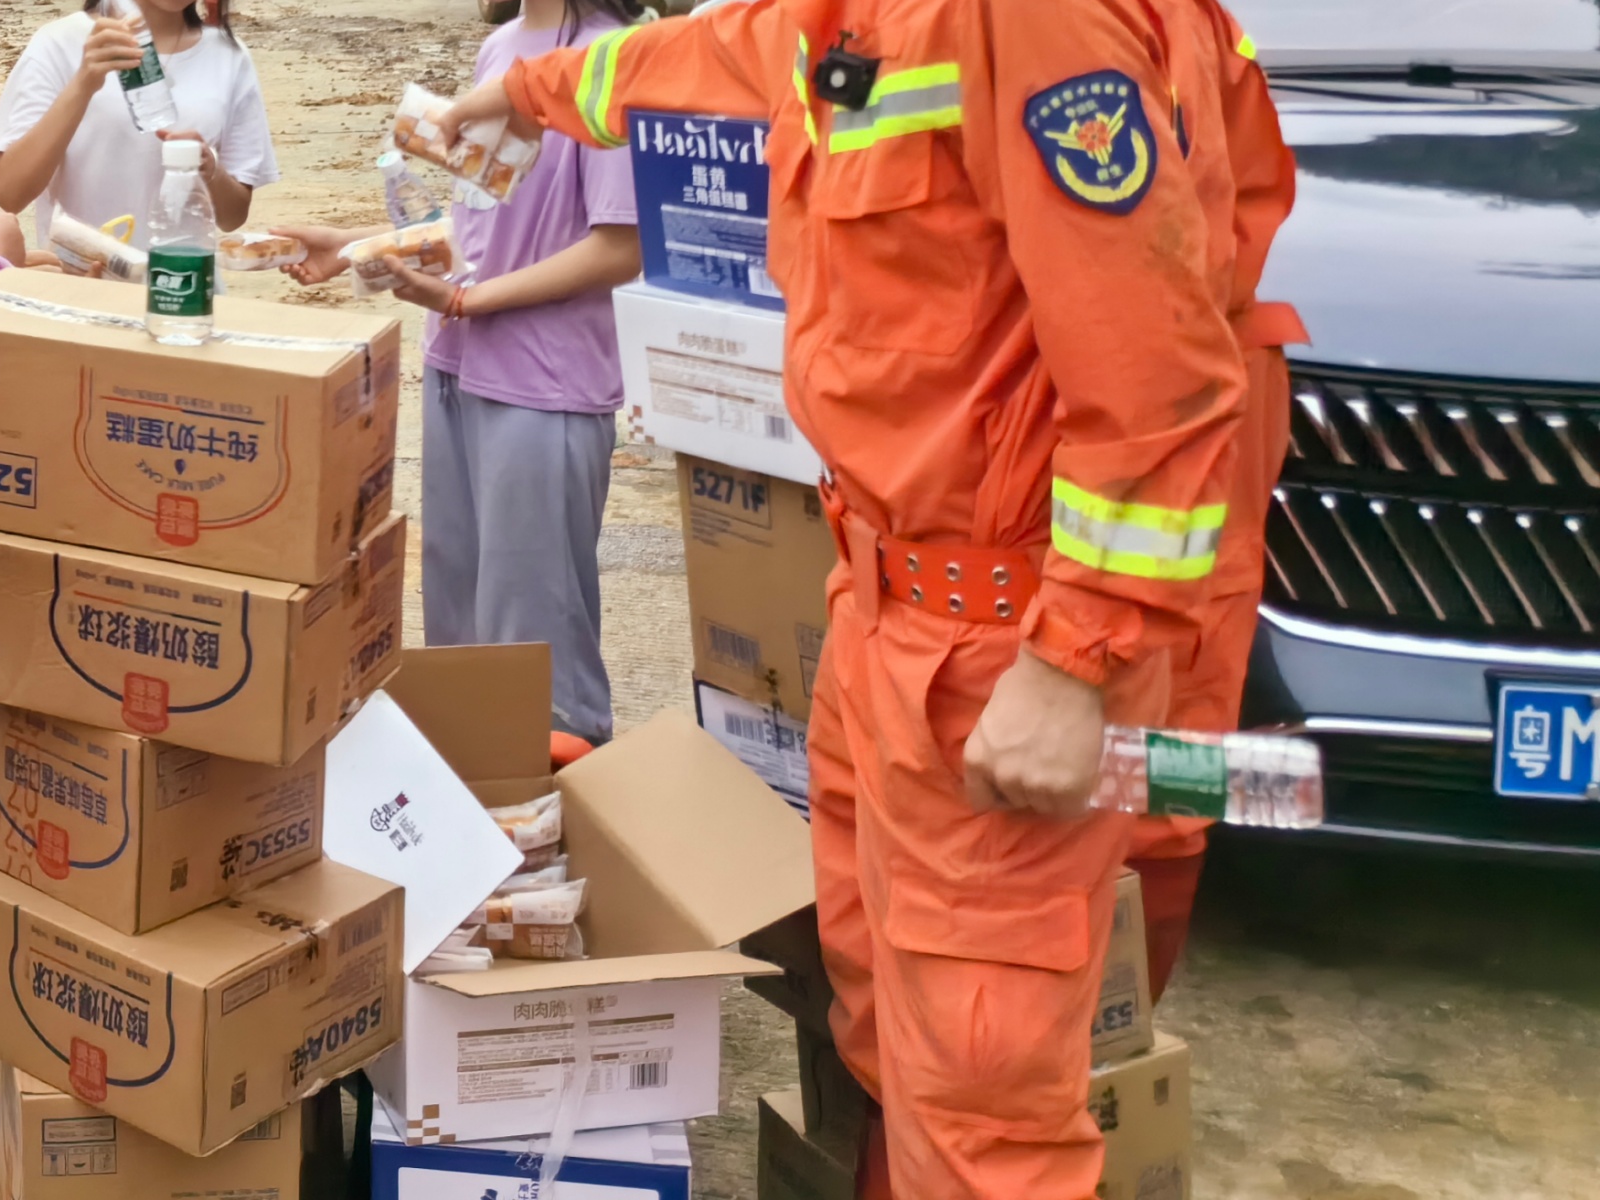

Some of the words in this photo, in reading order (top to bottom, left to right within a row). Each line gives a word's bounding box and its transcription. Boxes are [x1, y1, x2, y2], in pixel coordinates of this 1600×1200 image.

[106, 411, 259, 463] 纯牛奶蛋糕
[135, 459, 166, 484] CAKE
[166, 479, 194, 492] MILK
[78, 604, 220, 670] 酸奶爆浆球
[246, 818, 311, 865] 5553C
[33, 962, 149, 1048] 酸奶爆浆球
[305, 997, 382, 1062] 5840A
[514, 995, 606, 1022] 肉肉脆糕
